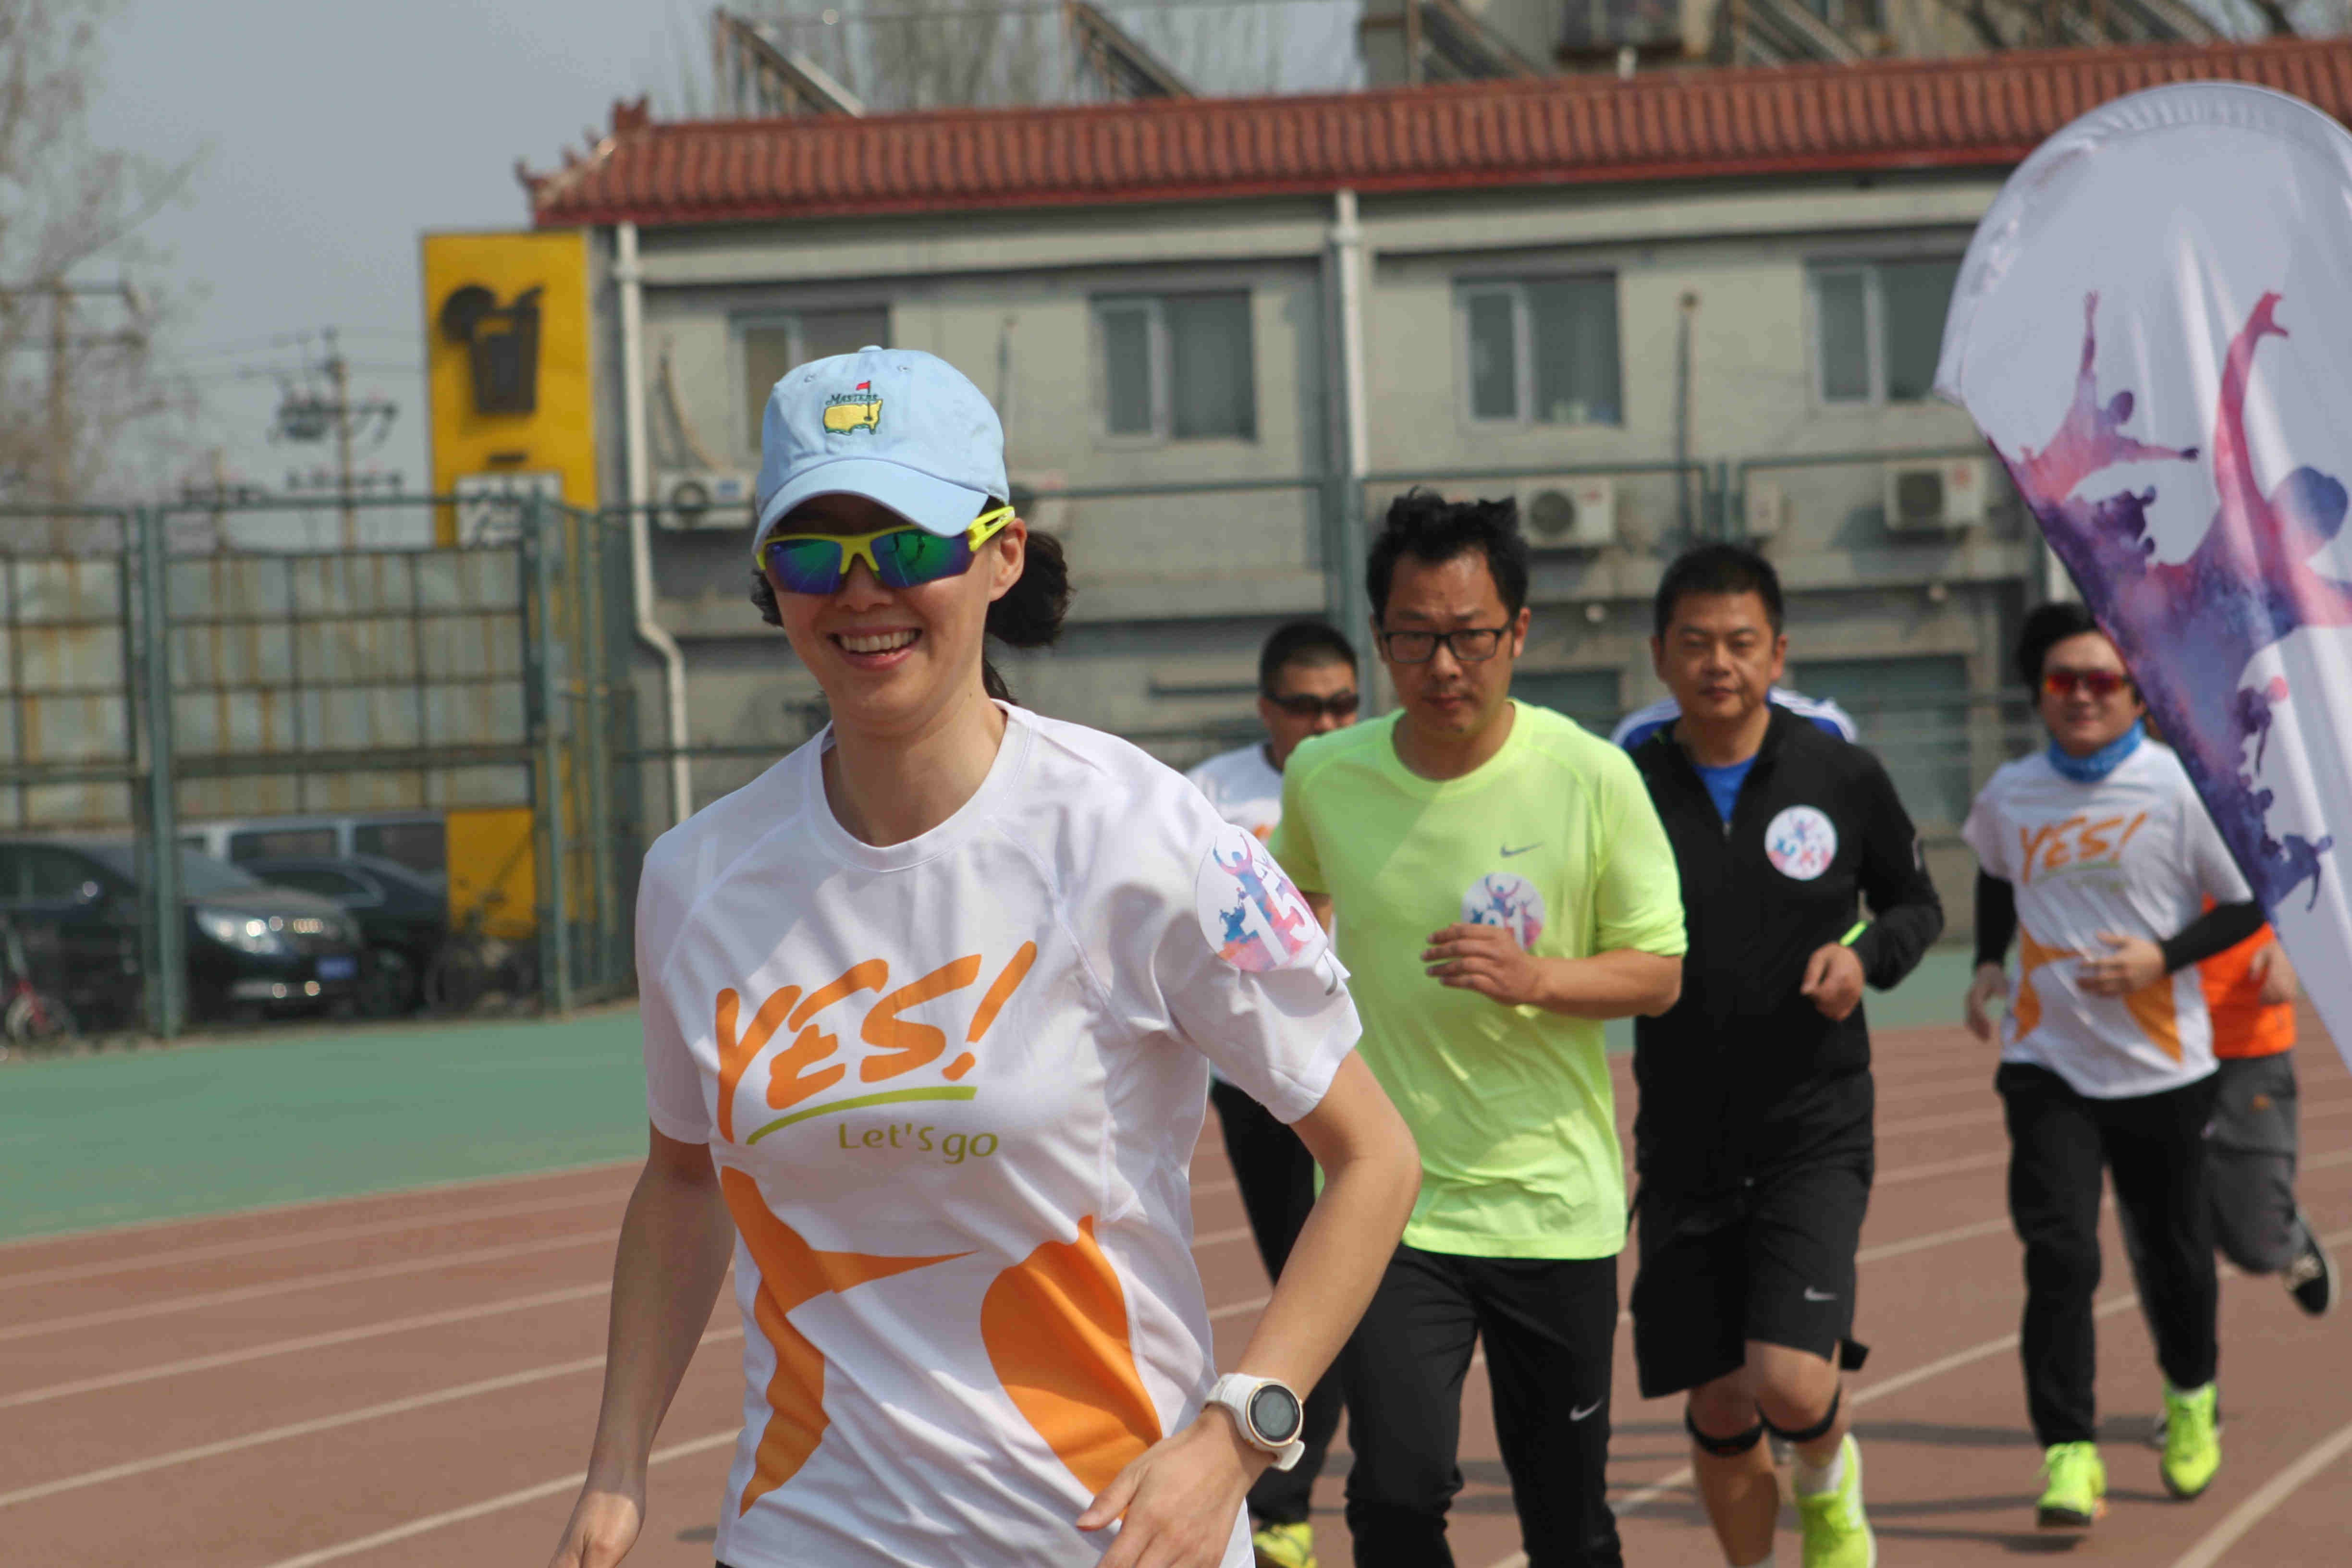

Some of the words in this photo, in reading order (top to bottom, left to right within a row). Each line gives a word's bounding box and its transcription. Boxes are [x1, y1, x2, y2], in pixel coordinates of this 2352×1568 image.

[825, 393, 878, 405] MASTERS
[2020, 812, 2148, 884] YES!
[1239, 869, 1317, 965] 15
[716, 940, 1038, 1144] YES!
[839, 1123, 935, 1152] Let's
[942, 1132, 999, 1165] go
